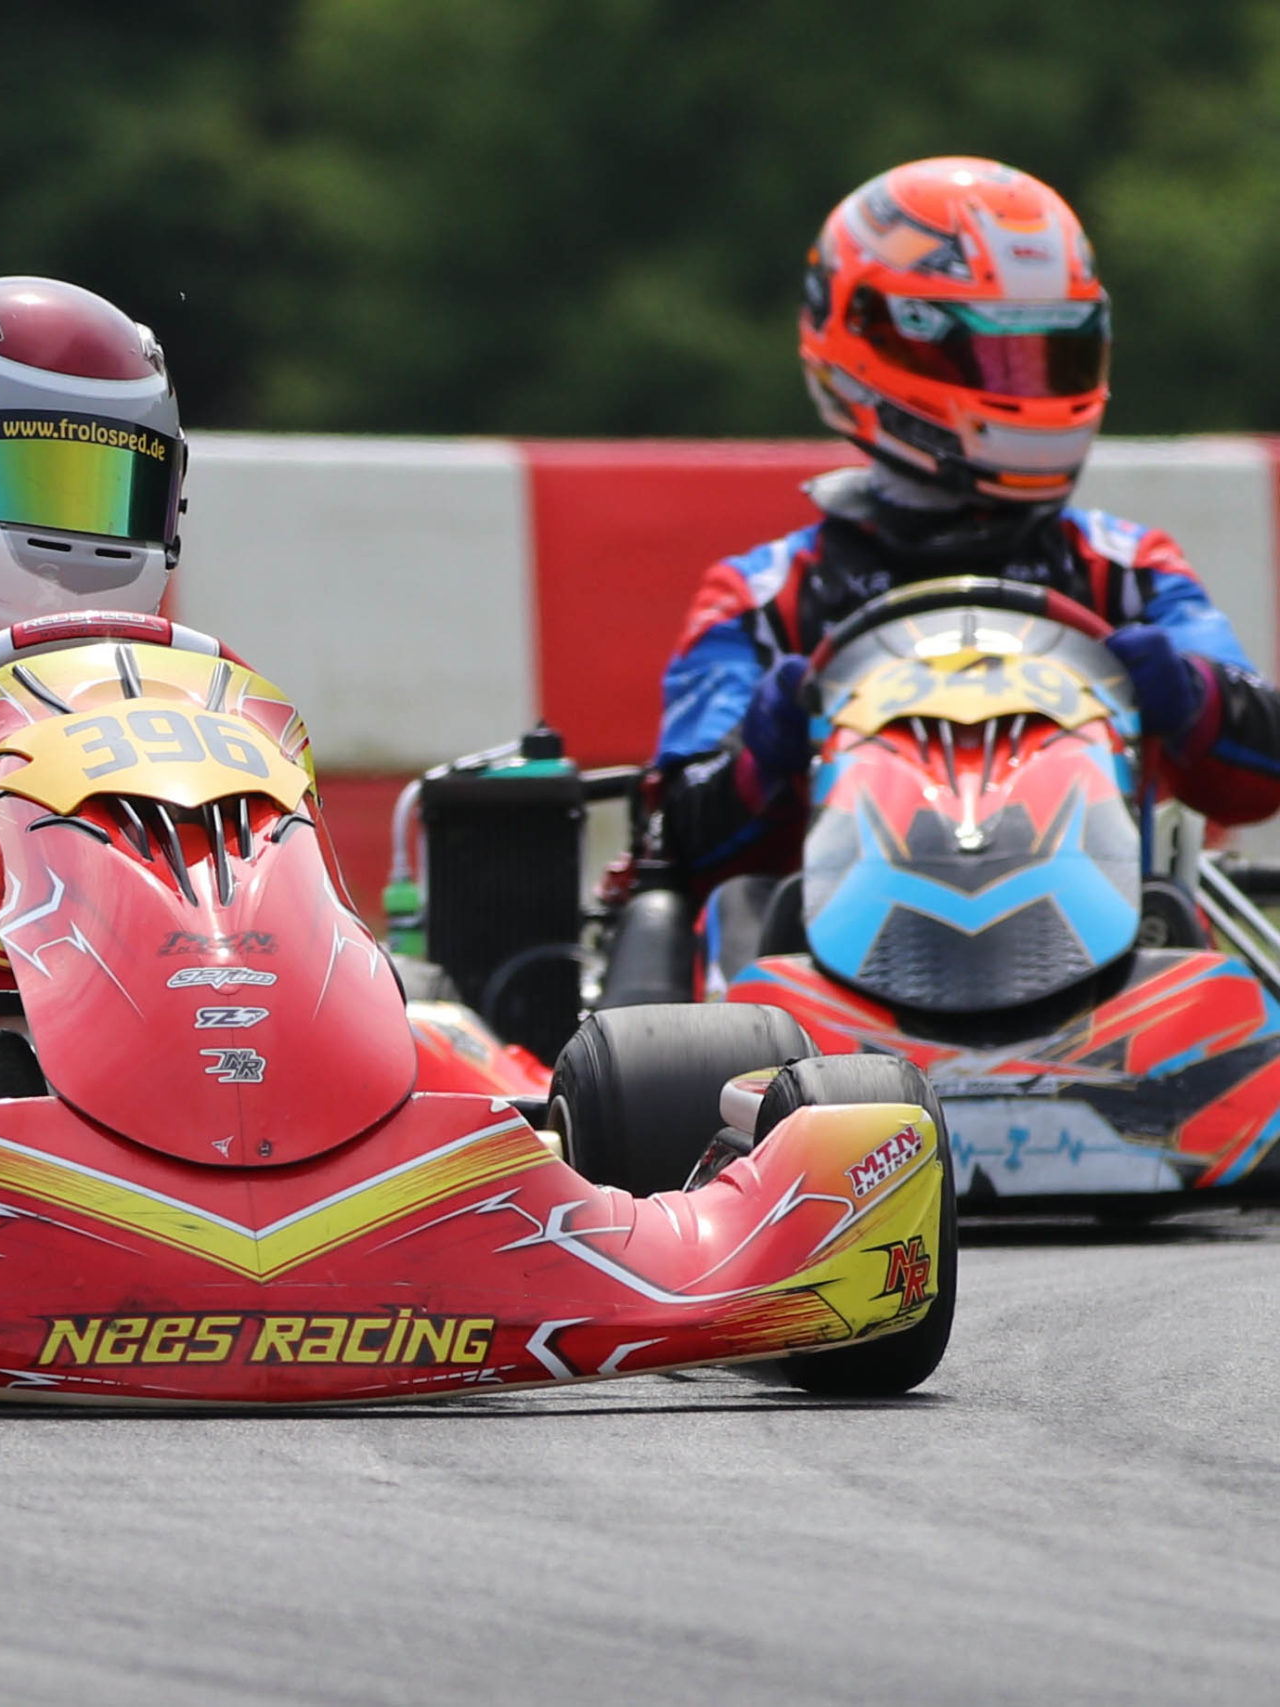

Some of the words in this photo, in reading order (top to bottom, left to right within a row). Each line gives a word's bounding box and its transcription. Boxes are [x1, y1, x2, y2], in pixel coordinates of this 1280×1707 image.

[2, 418, 166, 462] www.frolosped.de
[877, 657, 1080, 715] 349
[63, 709, 270, 781] 396
